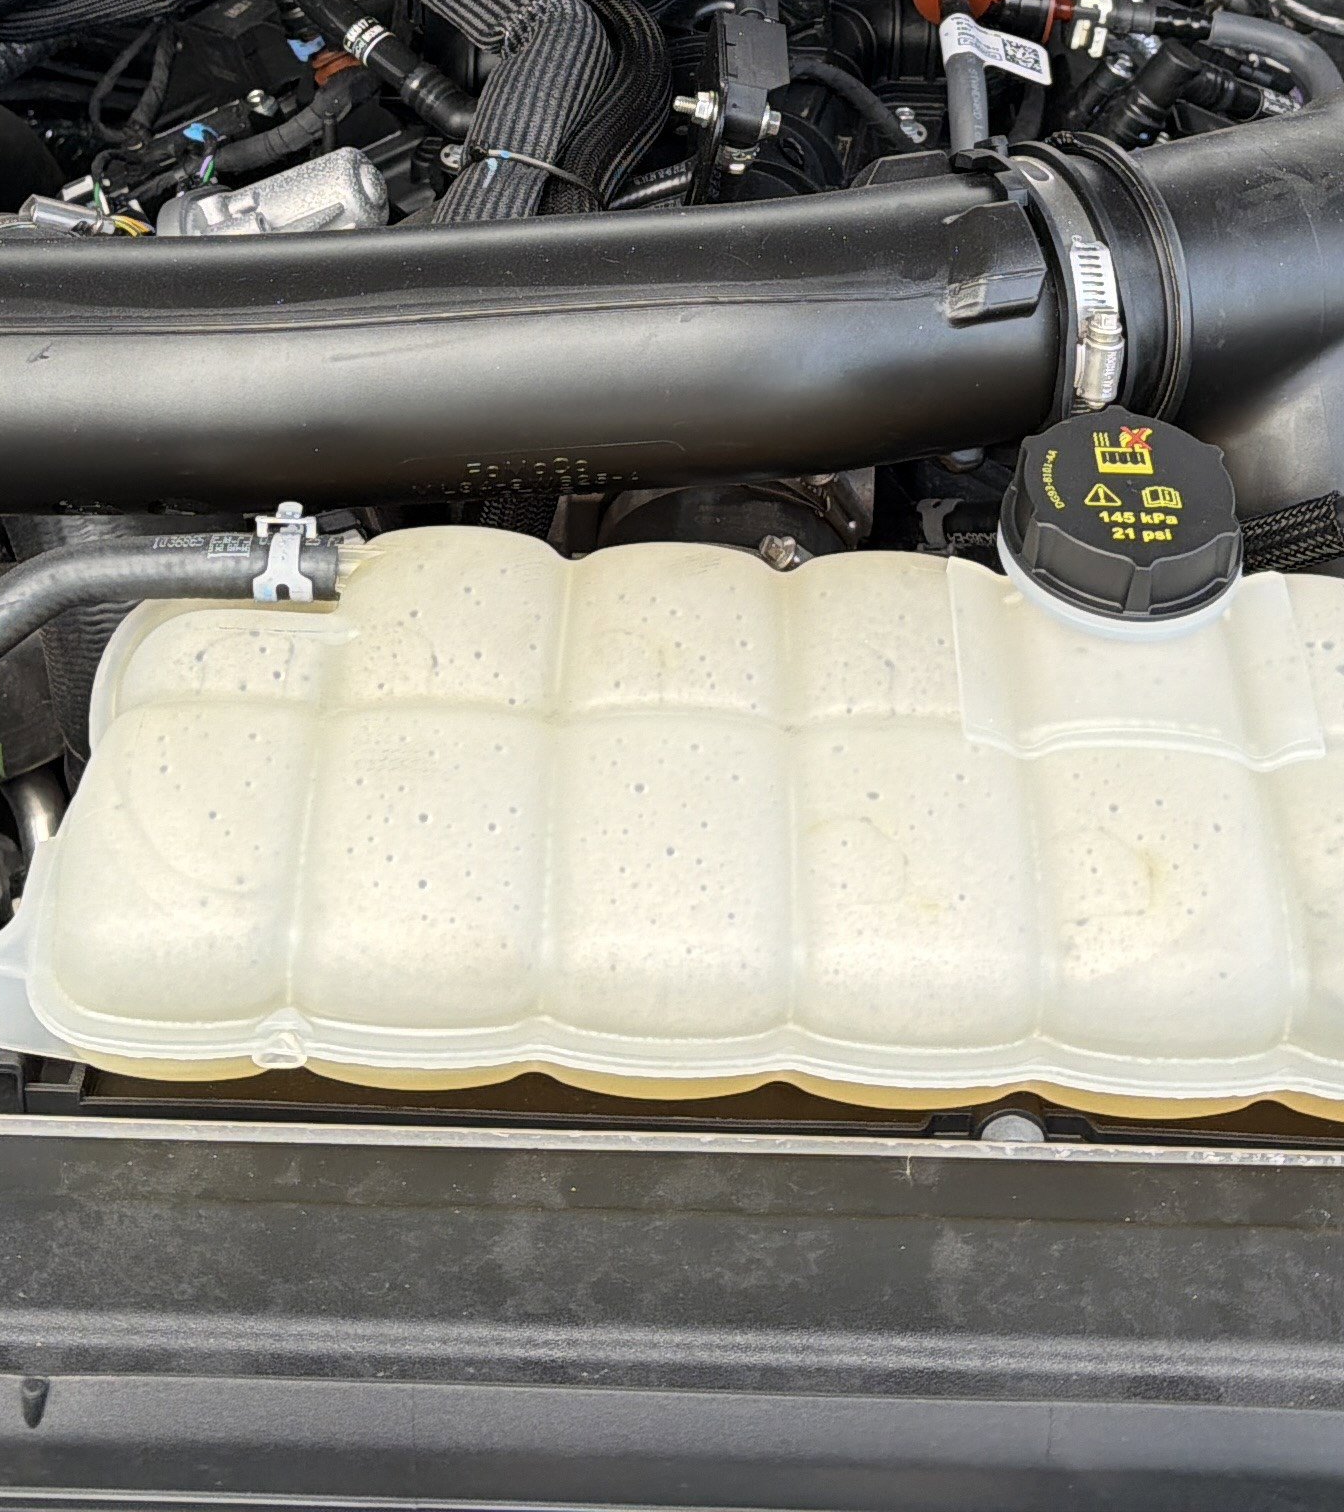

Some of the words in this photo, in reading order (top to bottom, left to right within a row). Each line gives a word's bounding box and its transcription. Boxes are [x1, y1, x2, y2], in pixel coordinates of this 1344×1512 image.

[1098, 511, 1136, 524] 145
[1140, 511, 1178, 525] kPa
[1112, 527, 1135, 540] 21
[1142, 529, 1173, 543] psi
